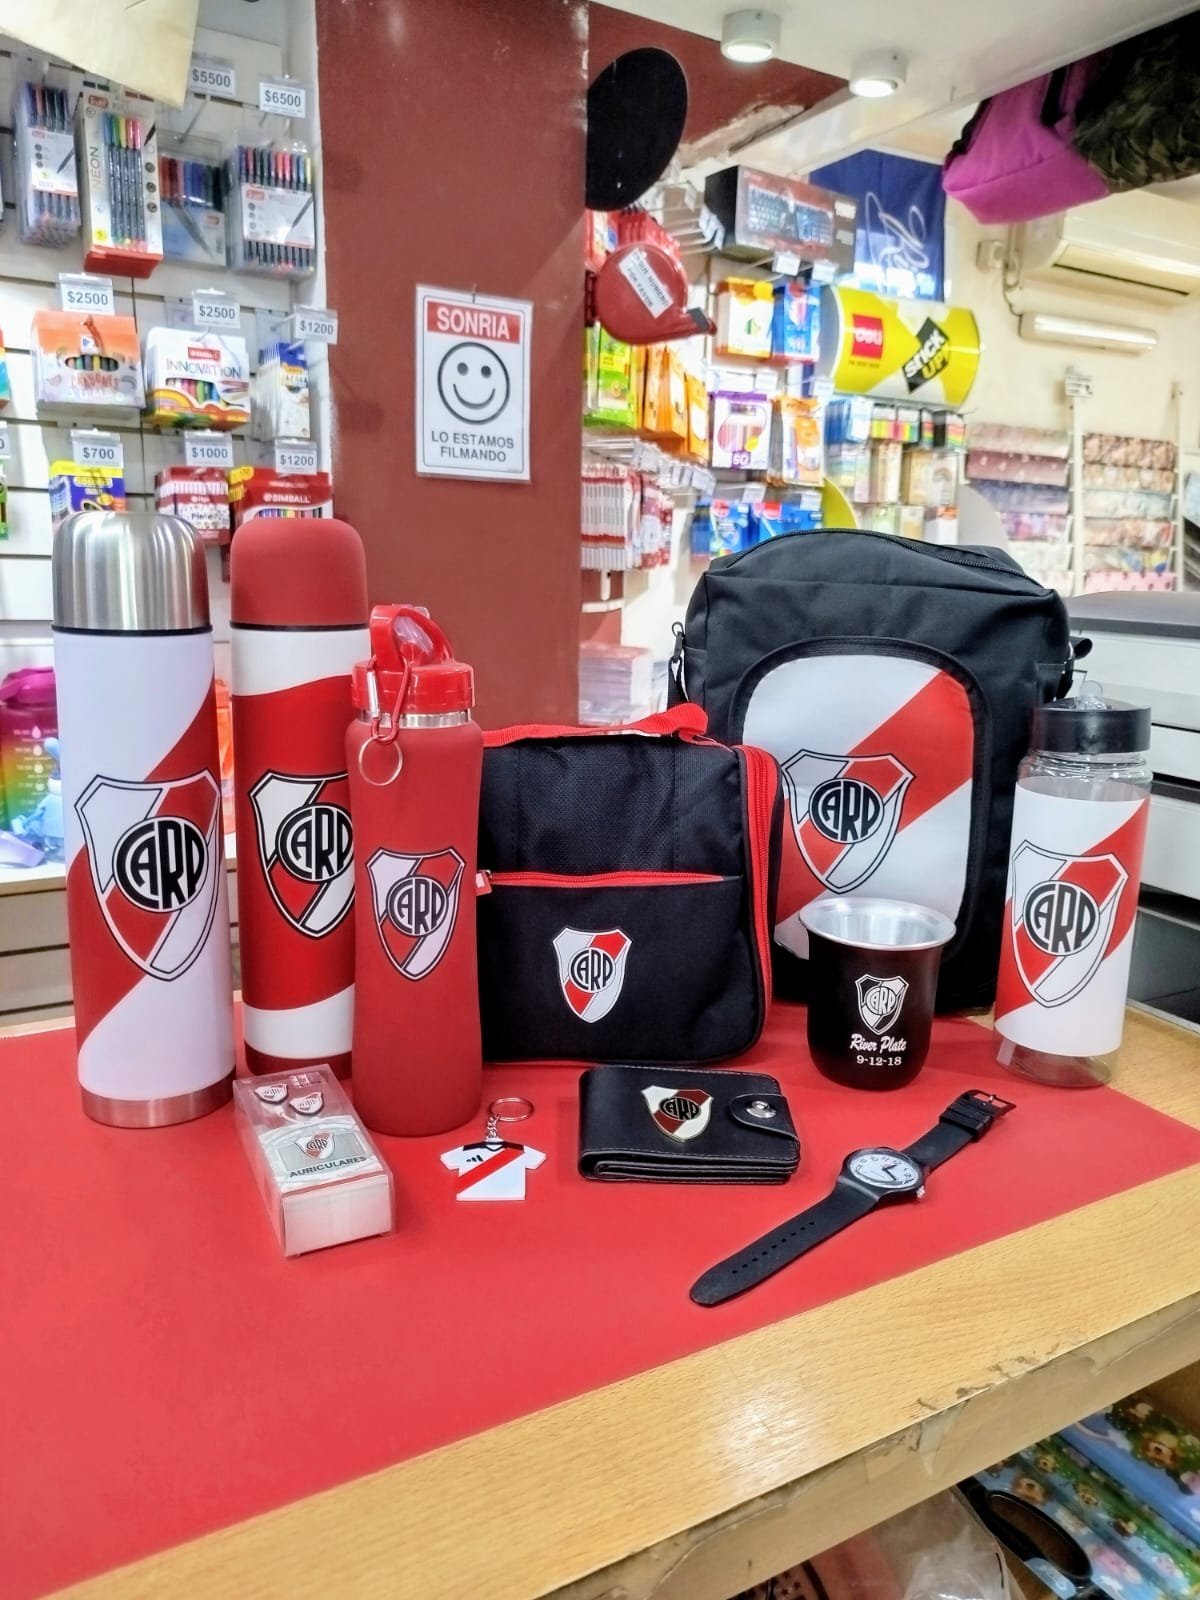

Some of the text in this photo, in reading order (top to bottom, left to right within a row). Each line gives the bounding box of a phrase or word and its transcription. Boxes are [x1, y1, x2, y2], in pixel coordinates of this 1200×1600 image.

[192, 68, 231, 88] $5500
[264, 89, 302, 108] $6500
[67, 290, 109, 306] $2500
[199, 305, 236, 320] $2500
[300, 320, 334, 335] $1200
[437, 306, 510, 340] SONRIA
[166, 358, 242, 380] INNOVATION
[431, 430, 515, 449] LO ESTAMOS
[83, 447, 115, 460] $700
[191, 447, 229, 460] $1000
[280, 454, 315, 467] $1200
[440, 446, 507, 463] FILMANDO
[849, 1033, 908, 1054] River Plate
[856, 1055, 903, 1066] 9-12-18
[289, 1155, 368, 1179] AURICULARES
